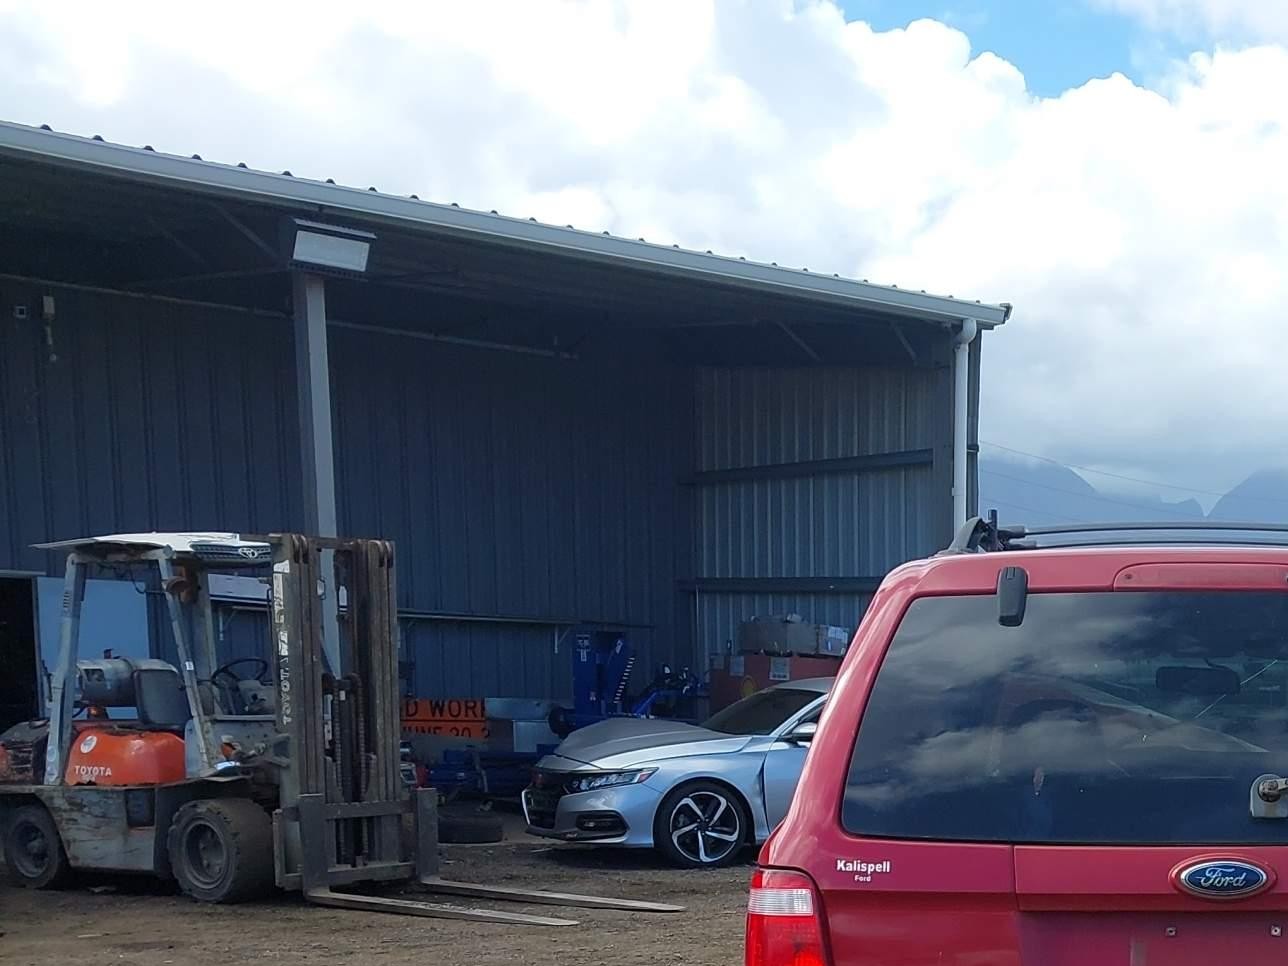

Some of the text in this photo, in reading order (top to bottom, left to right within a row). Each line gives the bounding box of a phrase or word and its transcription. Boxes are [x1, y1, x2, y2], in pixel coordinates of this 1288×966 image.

[75, 766, 112, 777] TOYOTA
[836, 859, 890, 874] Kalispell
[854, 874, 871, 882] Ford
[1196, 867, 1247, 887] Ford
